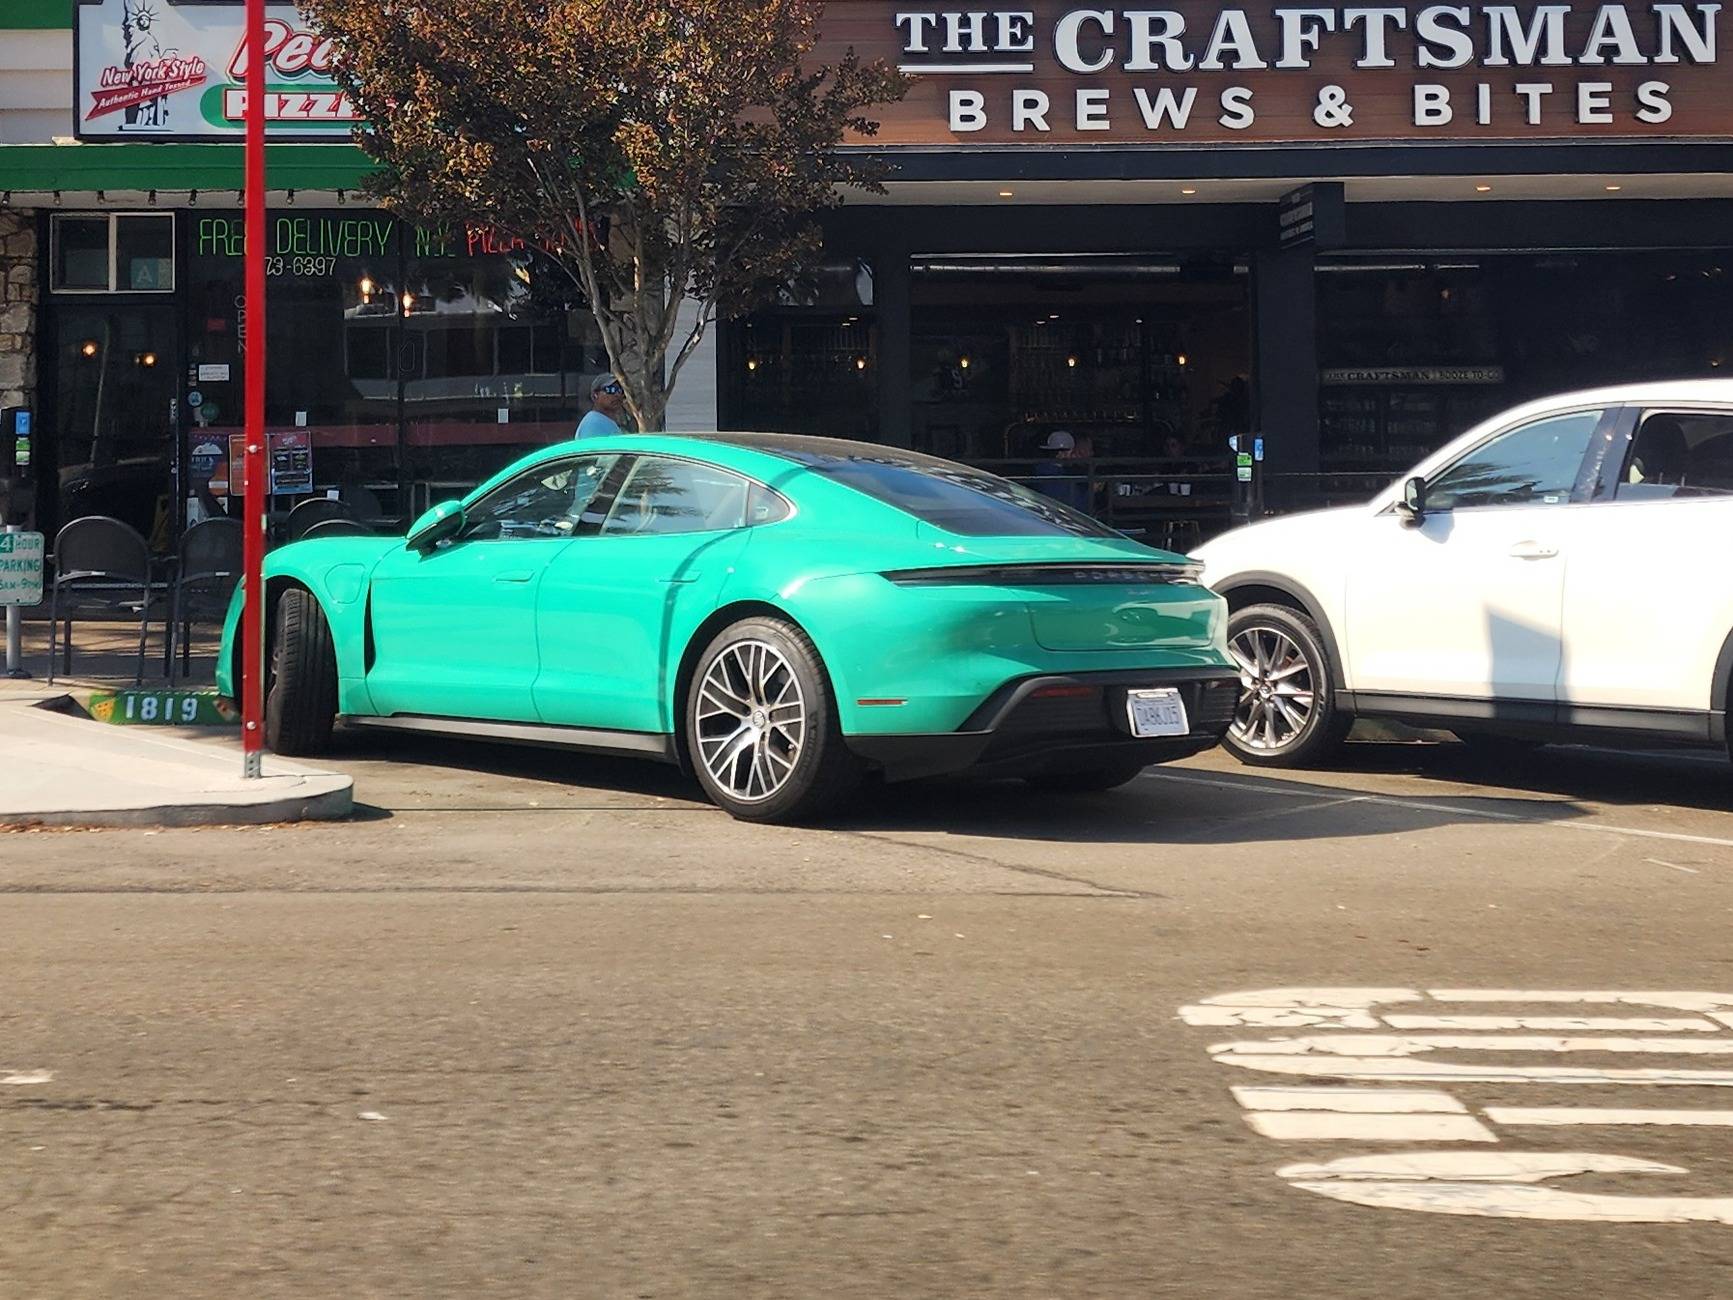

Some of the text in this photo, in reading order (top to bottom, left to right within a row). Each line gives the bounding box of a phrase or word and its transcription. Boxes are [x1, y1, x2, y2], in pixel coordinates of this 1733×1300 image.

[896, 4, 1721, 72] THE CRAFTSMAN
[101, 57, 205, 87] New York Style
[98, 91, 139, 109] Authentic
[949, 81, 1672, 132] BREWS & BITES
[200, 219, 248, 256] FRE
[277, 218, 393, 257] DELIVERY
[265, 256, 337, 276] 73-6397
[126, 695, 198, 722] 1819
